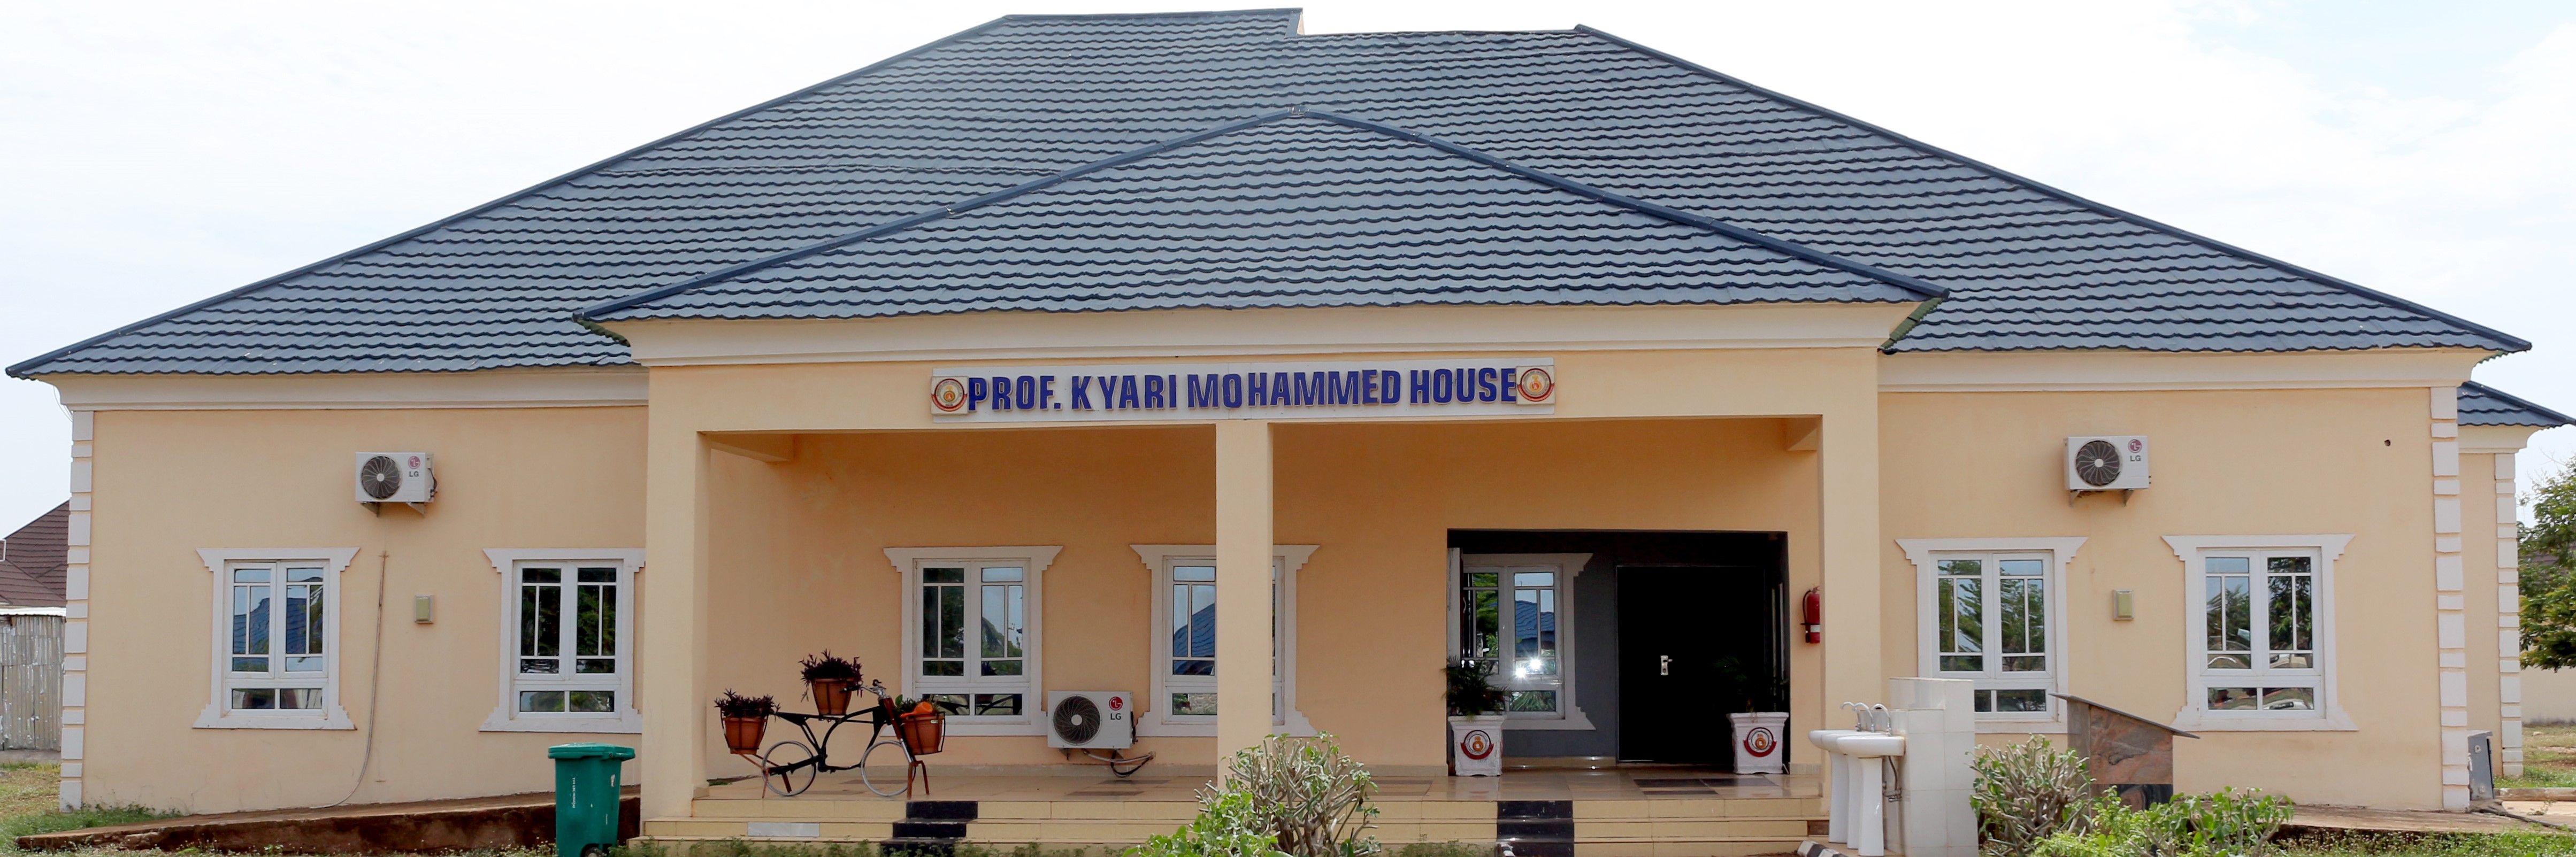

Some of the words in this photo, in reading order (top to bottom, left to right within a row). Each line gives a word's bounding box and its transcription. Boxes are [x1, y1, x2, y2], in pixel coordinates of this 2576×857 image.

[968, 375, 1062, 412] PROF.
[1070, 374, 1178, 411] KYARI
[1187, 369, 1401, 410] MOHAMMED
[1409, 367, 1518, 405] HOUSE
